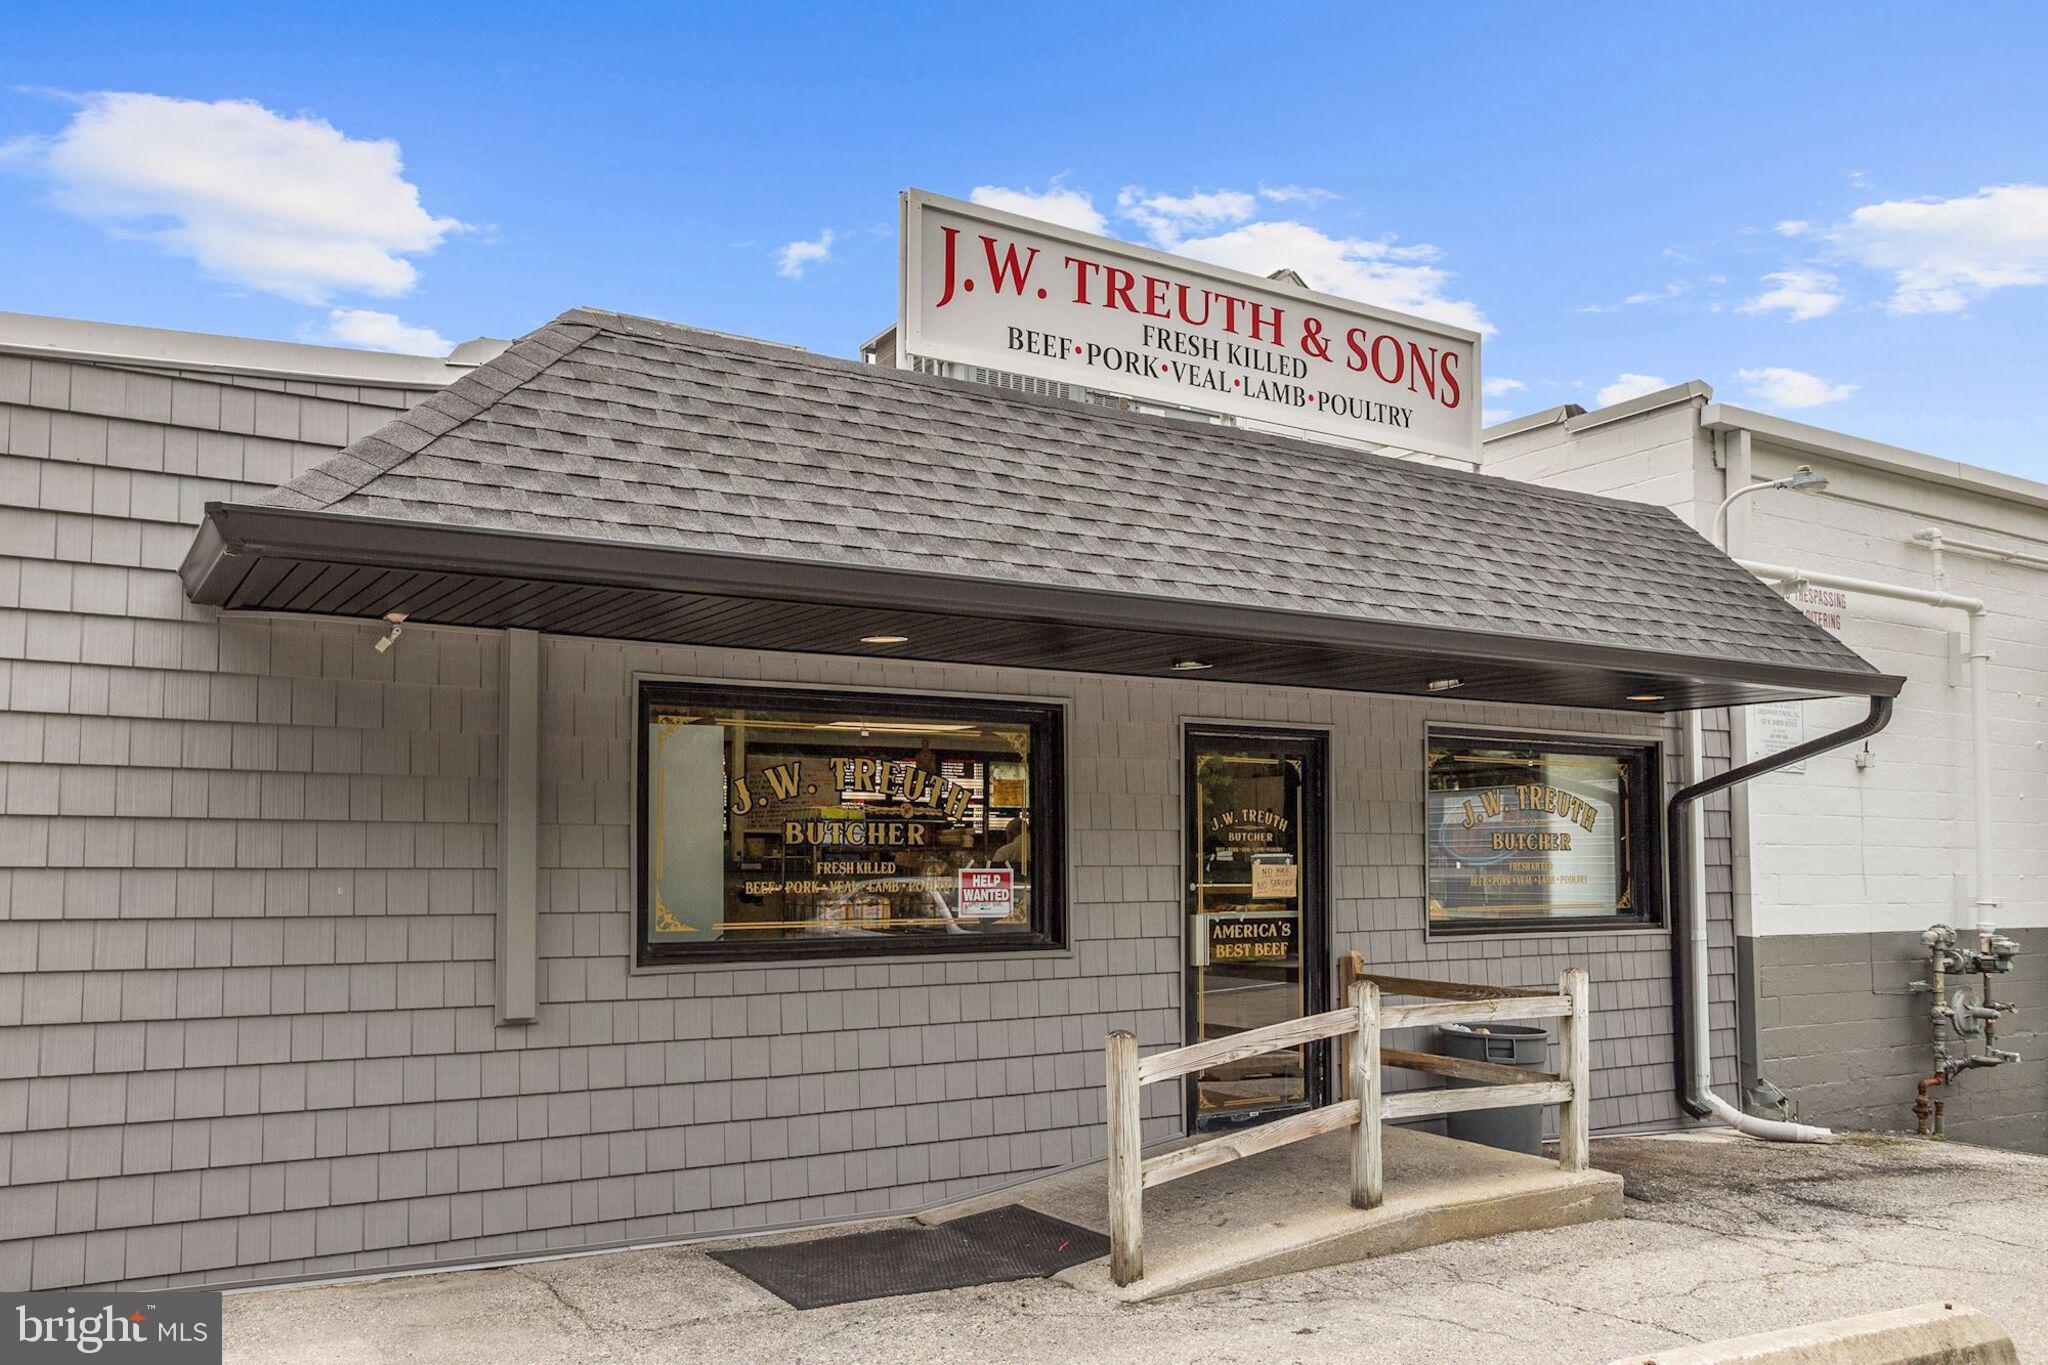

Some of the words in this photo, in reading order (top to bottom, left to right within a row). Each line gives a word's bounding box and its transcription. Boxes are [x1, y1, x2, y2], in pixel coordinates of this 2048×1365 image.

[937, 226, 1047, 308] J.W.
[1064, 256, 1285, 348] TREUTH
[1300, 317, 1334, 363] &
[1346, 328, 1460, 409] SONS
[1142, 324, 1219, 362] FRESH
[1227, 342, 1307, 380] KILLED
[1007, 326, 1072, 360] BEEF
[1086, 342, 1161, 379] PORK
[1171, 360, 1232, 393] VEAL
[1243, 375, 1306, 408] LAMB
[1317, 391, 1413, 428] POULTRY
[1801, 609, 1841, 630] OITERING
[829, 757, 972, 823] TREUTH
[1515, 784, 1598, 833] TREUTH
[1242, 809, 1288, 832] TREUTH
[784, 821, 925, 847] BUTCHER
[1228, 832, 1274, 842] BUTCHER
[1492, 832, 1572, 851] BUTCHER
[816, 862, 854, 875] FRESH
[857, 862, 896, 875] KILLED
[786, 881, 818, 895] PORK
[972, 874, 1001, 888] HELP
[963, 888, 1010, 902] WANTED
[1213, 921, 1292, 939] AMERICA'S
[1216, 943, 1252, 958] BEST
[1255, 942, 1289, 957] BEEF
